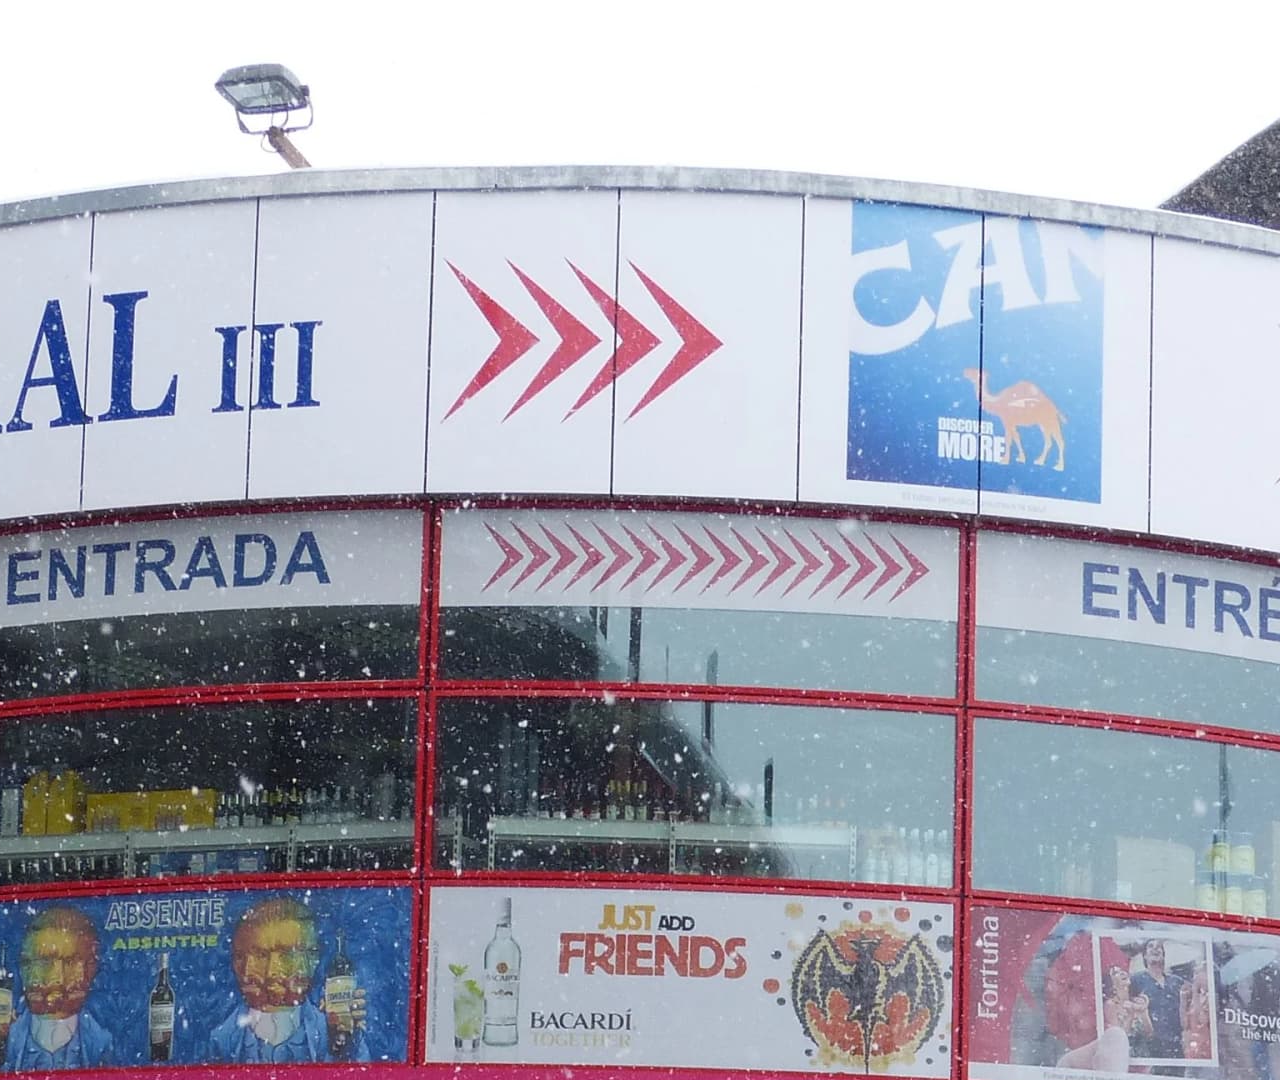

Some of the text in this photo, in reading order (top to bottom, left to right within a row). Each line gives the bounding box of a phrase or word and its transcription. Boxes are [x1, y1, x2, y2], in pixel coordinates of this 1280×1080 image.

[212, 320, 323, 413] III
[937, 416, 994, 436] DISCOVER
[937, 431, 1007, 464] MORE
[6, 530, 331, 606] ENTRADA
[104, 897, 226, 931] ABSENTE
[597, 903, 695, 932] JUST ADD
[111, 934, 219, 951] ABSINTHE
[557, 931, 748, 980] FRIENDS
[977, 915, 1000, 1020] Fortuna
[530, 1008, 632, 1031] BACARDÍ
[531, 1032, 631, 1049] TOGETHER
